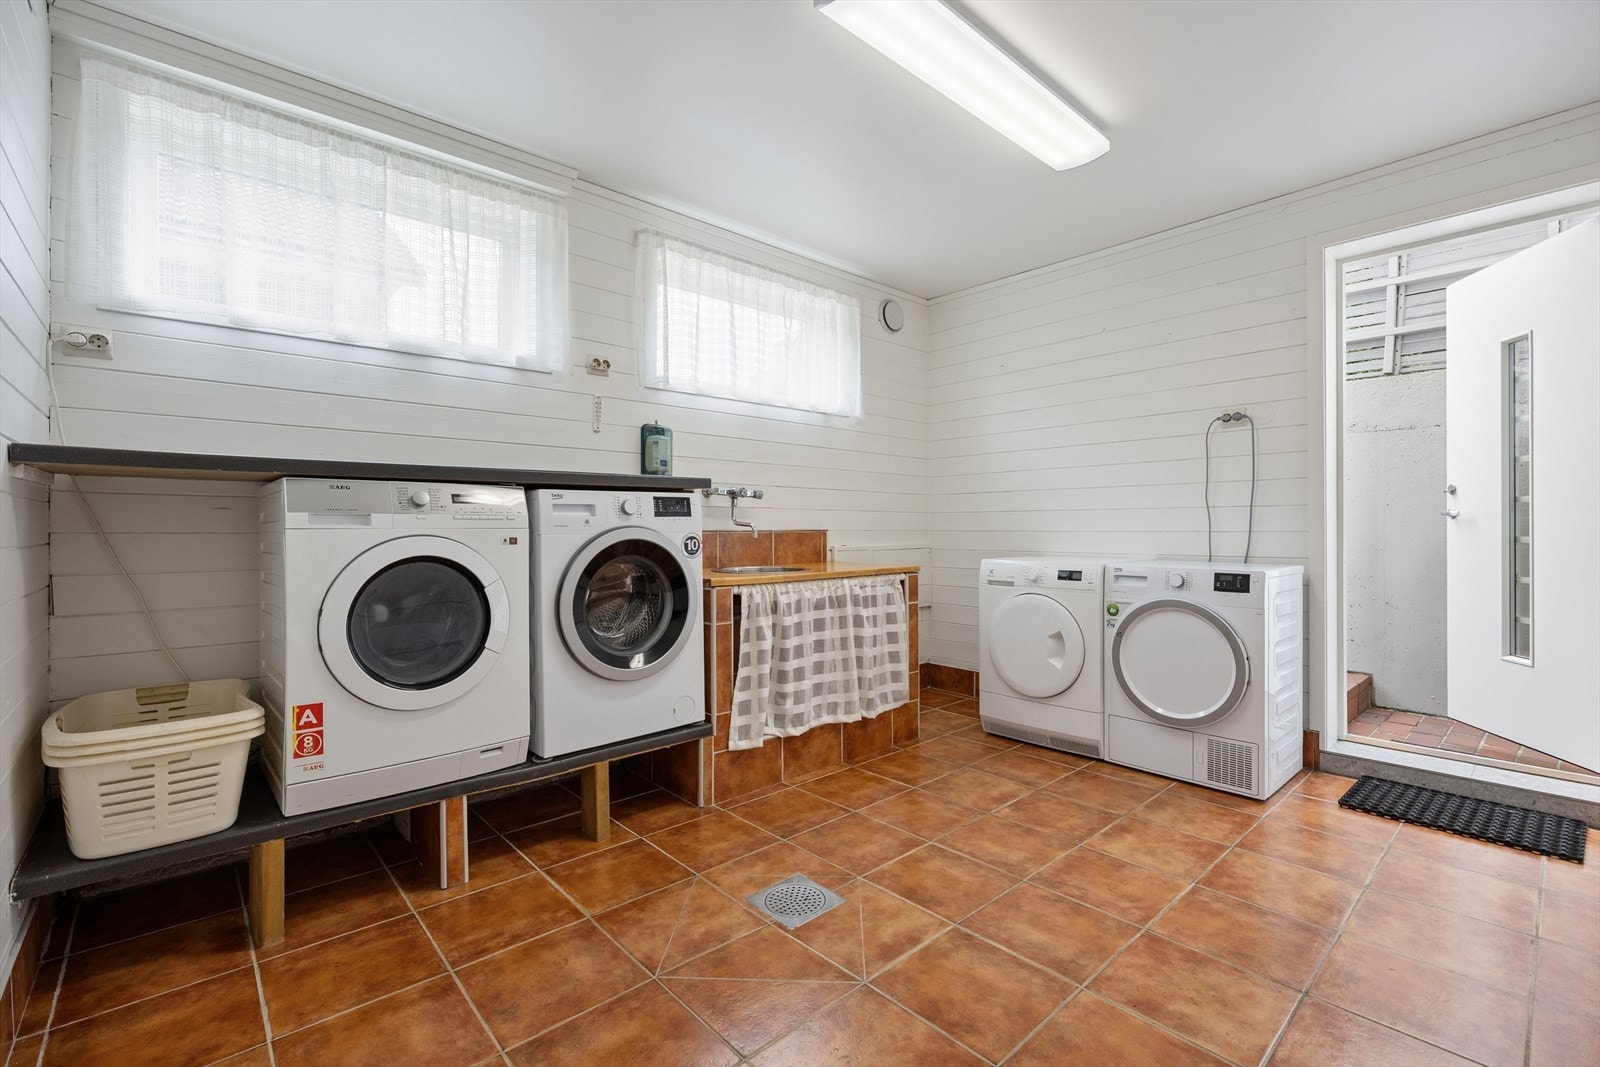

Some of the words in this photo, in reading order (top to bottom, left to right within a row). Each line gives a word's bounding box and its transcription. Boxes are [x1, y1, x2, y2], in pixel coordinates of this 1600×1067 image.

[685, 539, 699, 551] 10
[299, 709, 318, 726] A
[303, 736, 313, 748] 8
[310, 763, 324, 771] AEG
